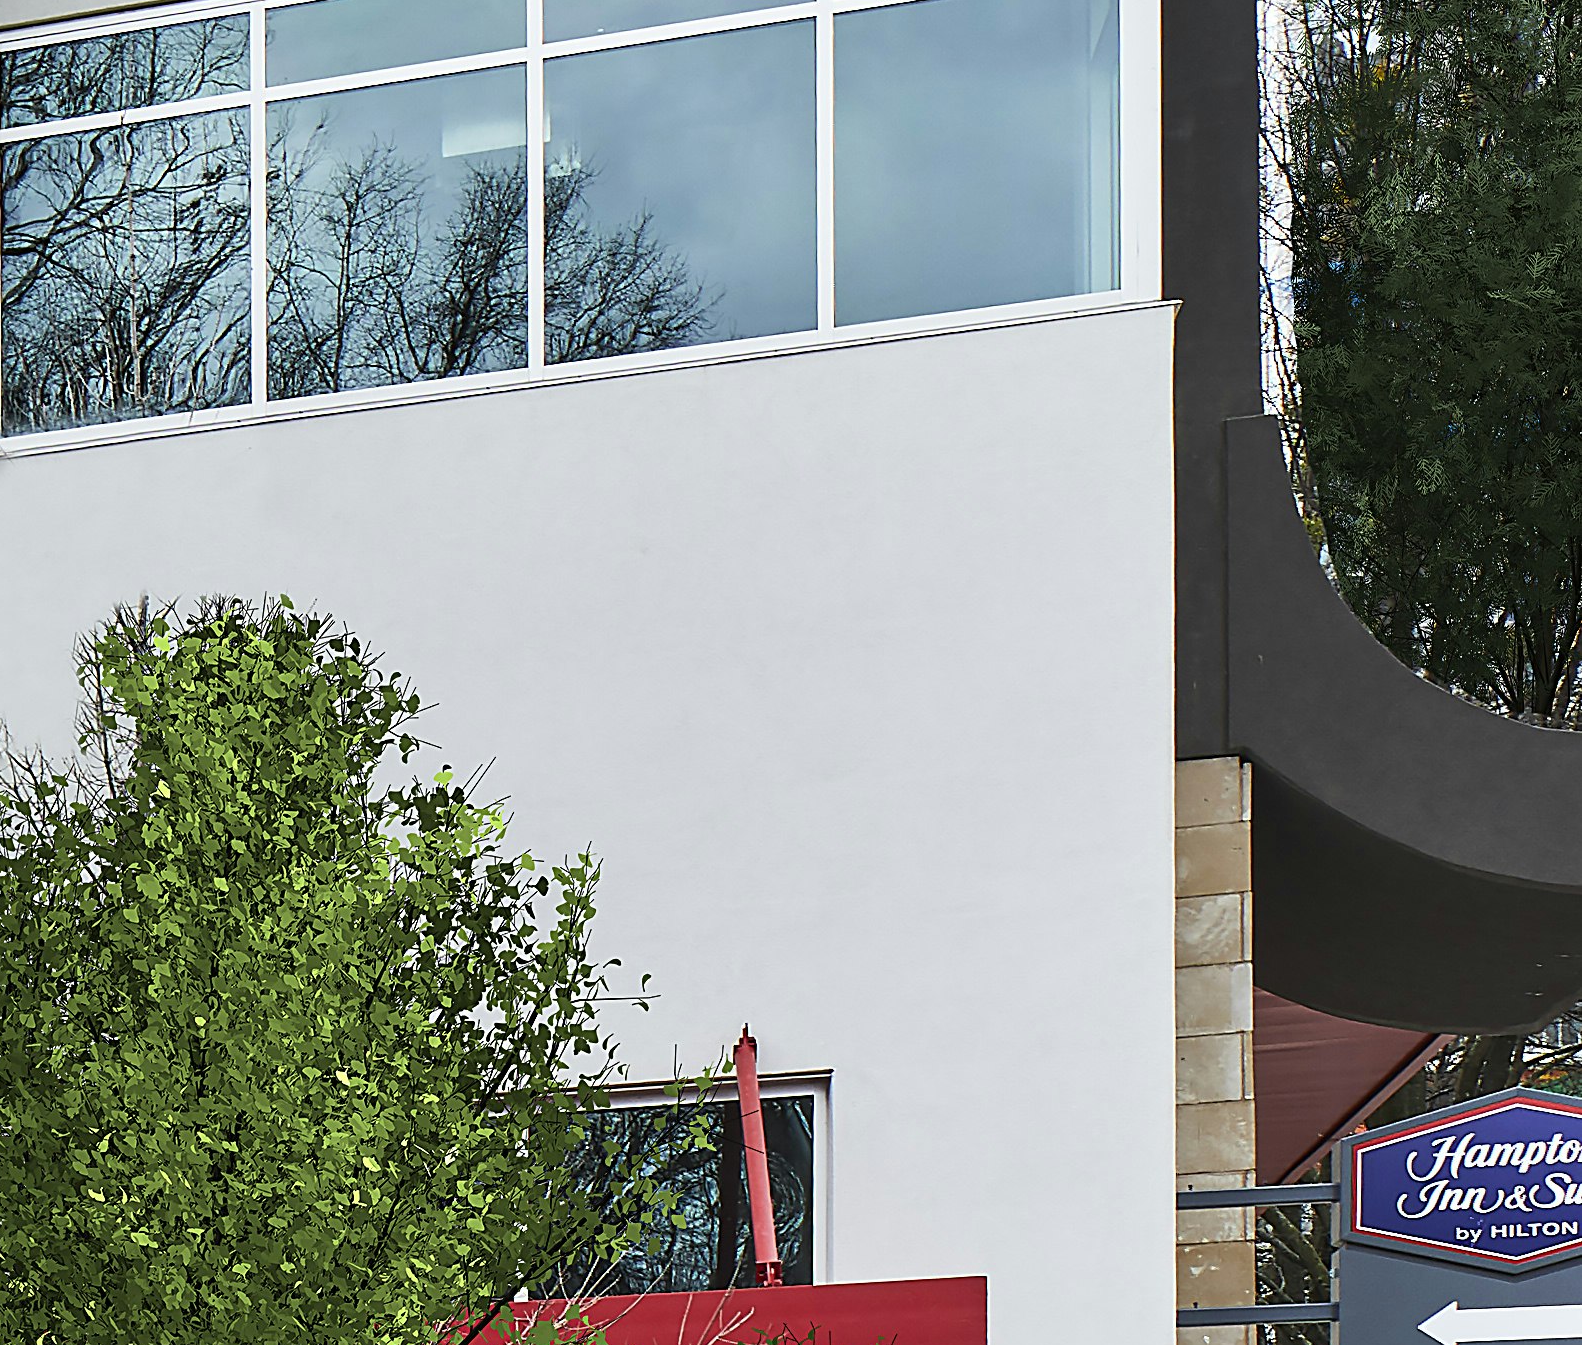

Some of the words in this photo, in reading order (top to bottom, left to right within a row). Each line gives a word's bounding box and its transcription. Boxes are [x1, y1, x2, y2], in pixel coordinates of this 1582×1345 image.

[1406, 1132, 1582, 1182] Hampto
[1396, 1179, 1505, 1219] Inn
[1504, 1185, 1532, 1212] &
[1456, 1227, 1482, 1243] by
[1491, 1221, 1579, 1239] HILTON
